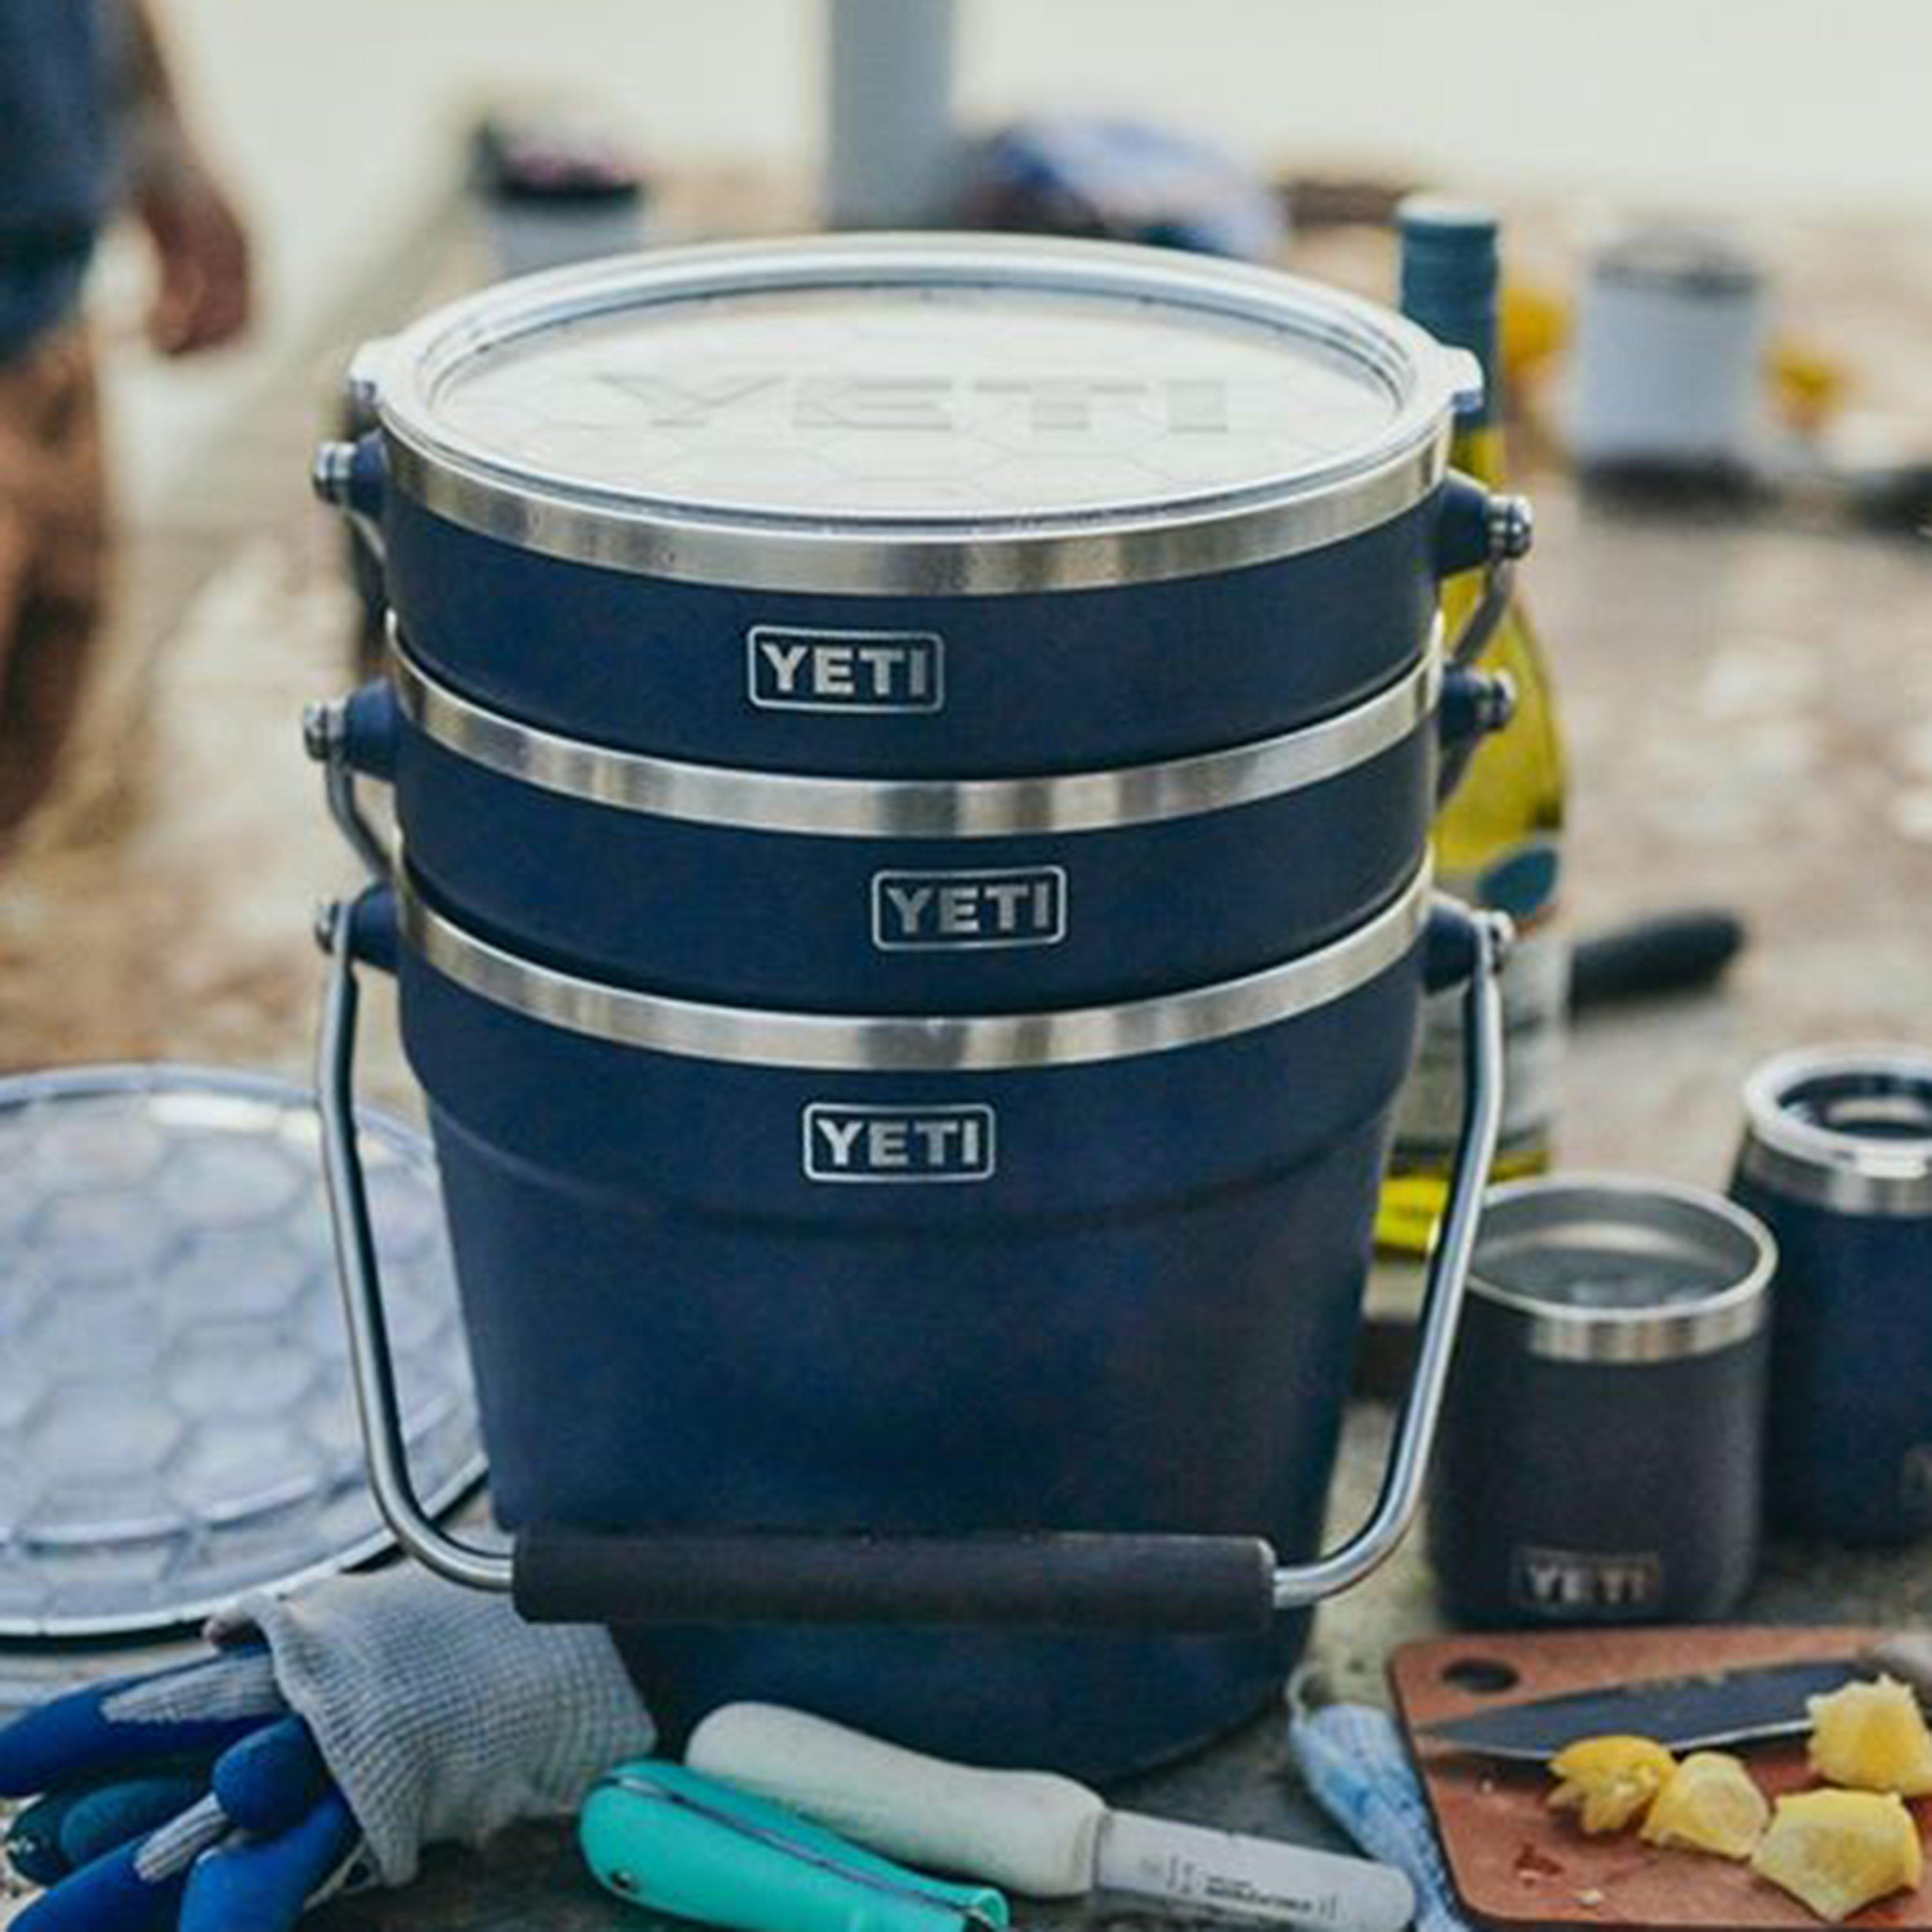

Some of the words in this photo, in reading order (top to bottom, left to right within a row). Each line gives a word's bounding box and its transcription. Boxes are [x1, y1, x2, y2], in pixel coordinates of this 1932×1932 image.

[760, 641, 928, 696] YETI
[885, 882, 1051, 934] YETI
[816, 1118, 980, 1166] YETI
[1526, 1562, 1648, 1605] YETI
